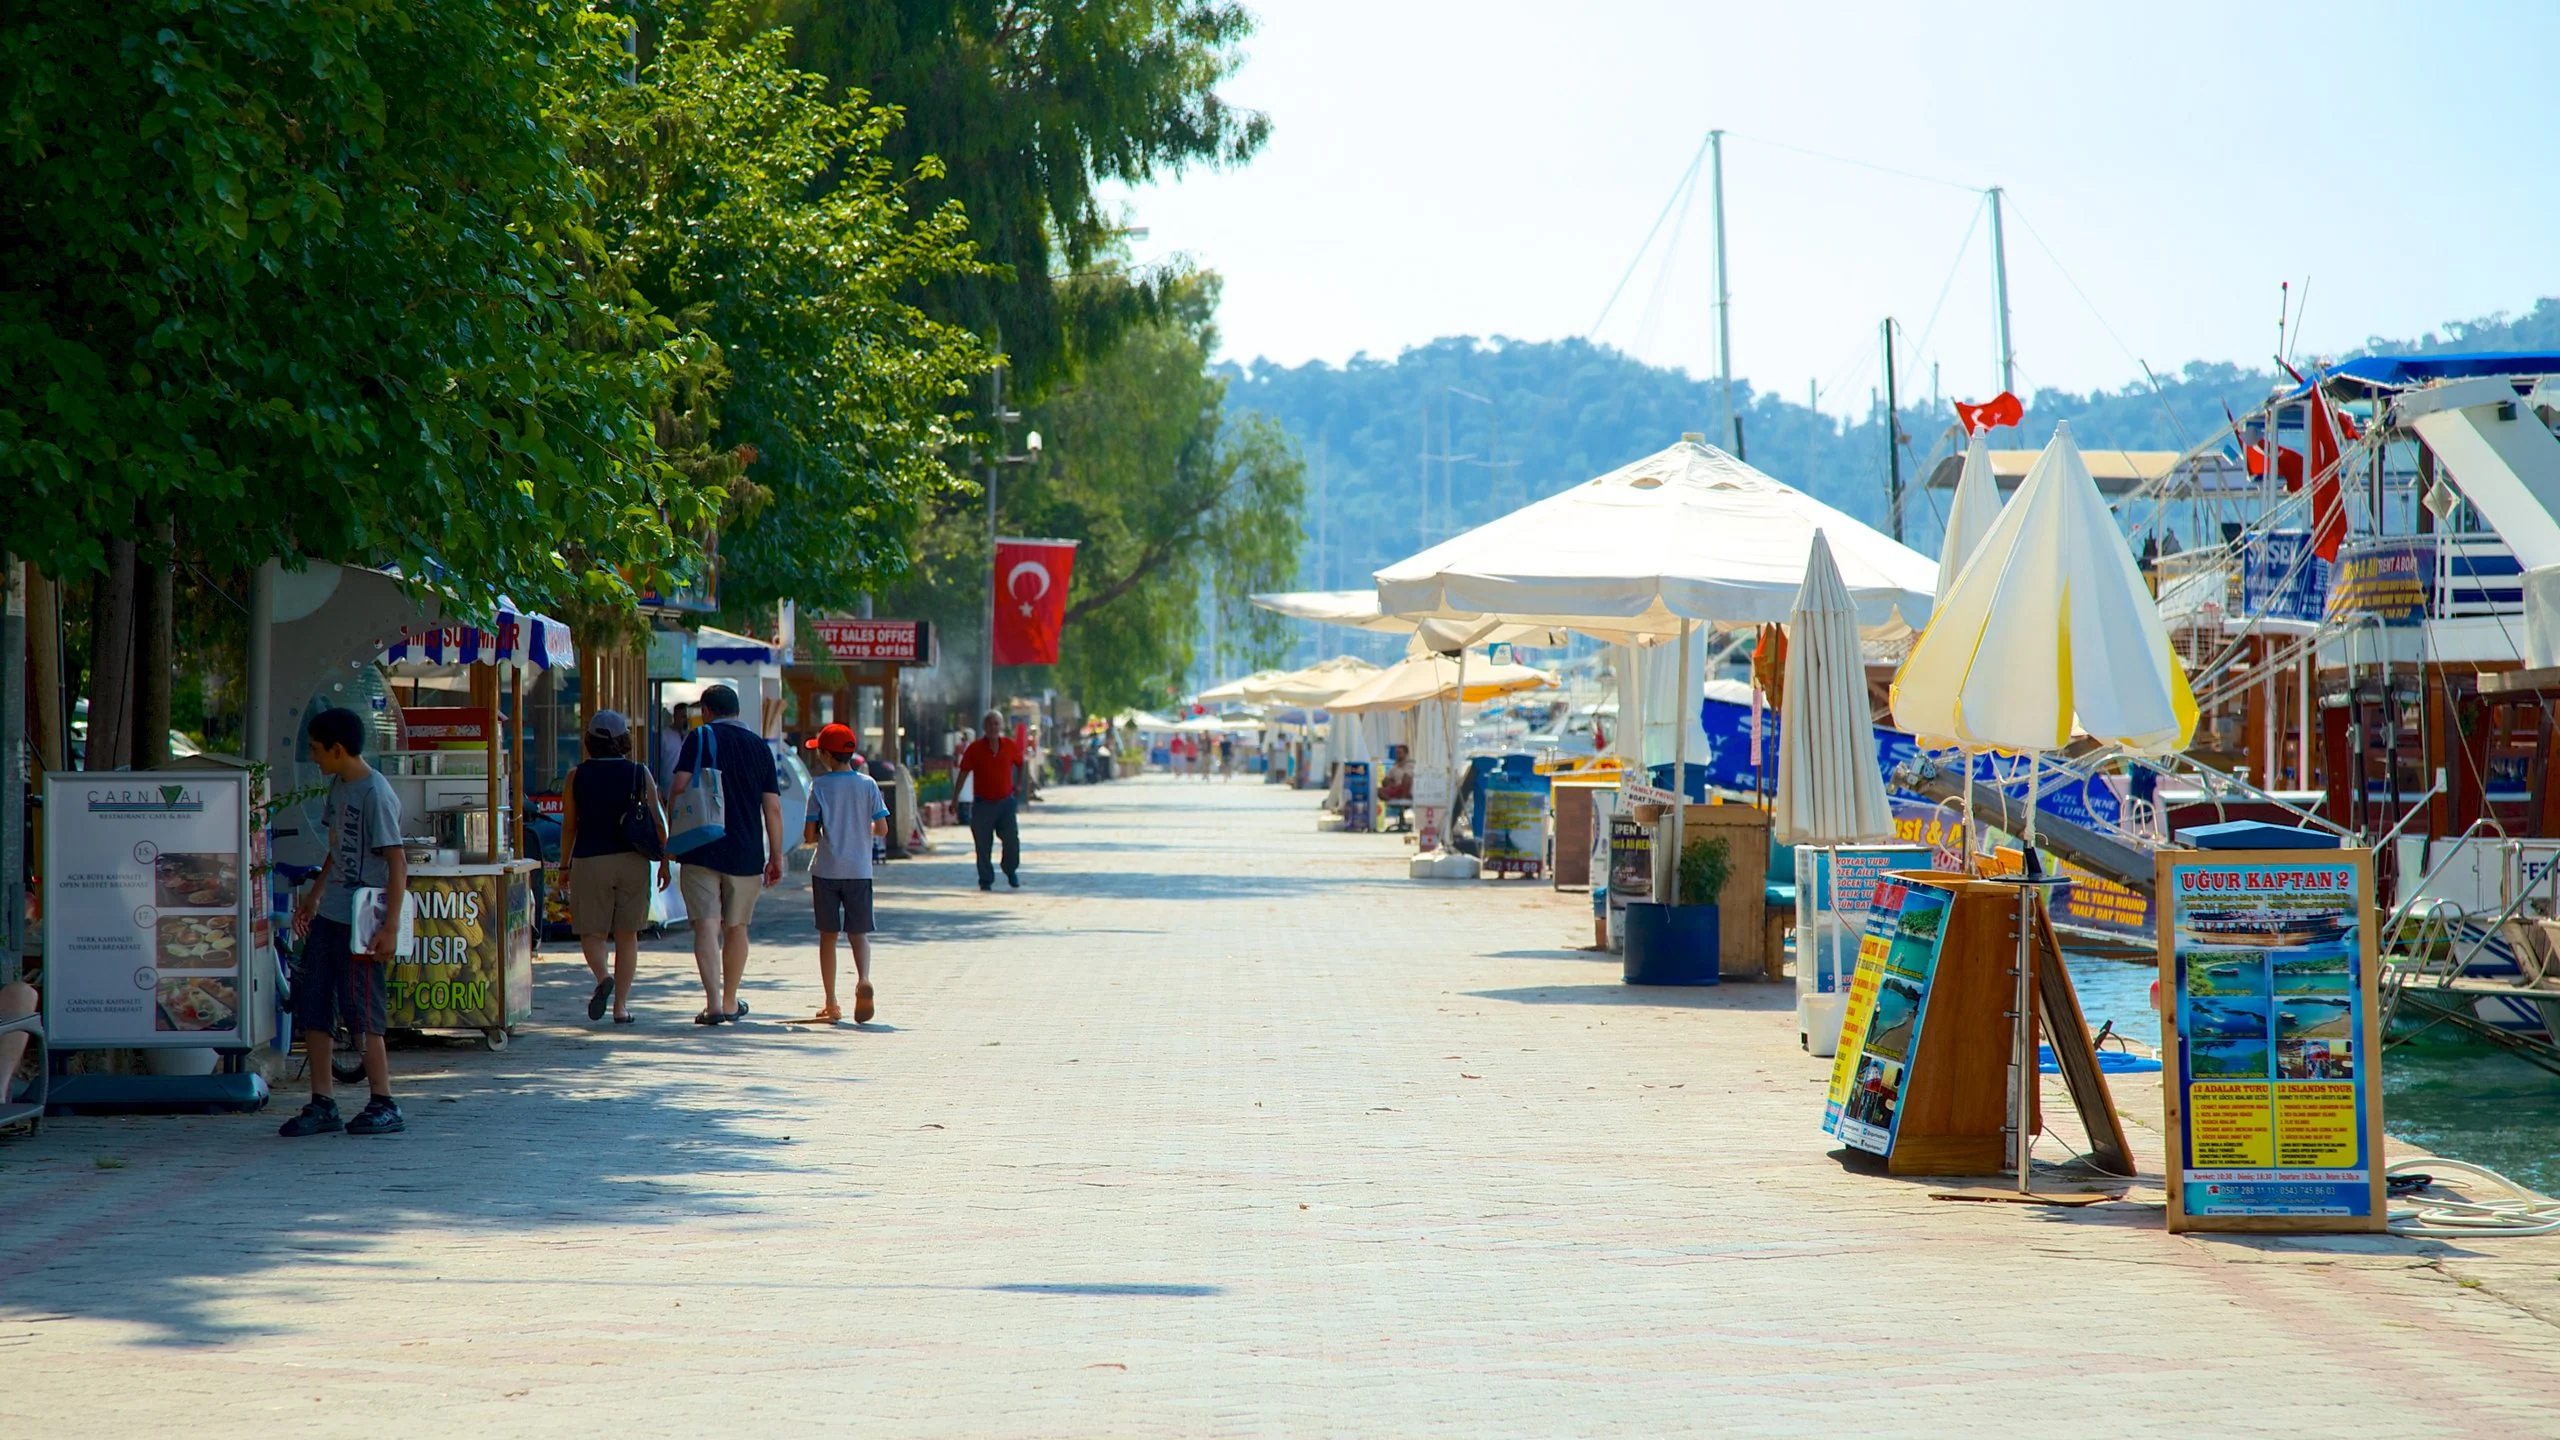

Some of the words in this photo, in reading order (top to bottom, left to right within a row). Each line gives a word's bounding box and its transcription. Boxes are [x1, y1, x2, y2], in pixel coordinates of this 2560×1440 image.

[841, 629, 875, 643] SALES
[877, 629, 915, 643] OFFICE
[87, 786, 203, 806] CARNIVAL
[1868, 857, 1890, 866] TURU
[2182, 870, 2242, 891] UĞUR
[2246, 872, 2332, 891] KAPTAN
[2338, 871, 2349, 890] 2
[2092, 892, 2114, 906] YEAR
[2115, 896, 2147, 912] ROUND
[2096, 907, 2114, 921] DAY
[2115, 911, 2143, 927] TOURS
[396, 936, 468, 964] MISIR
[415, 981, 486, 1010] CORN
